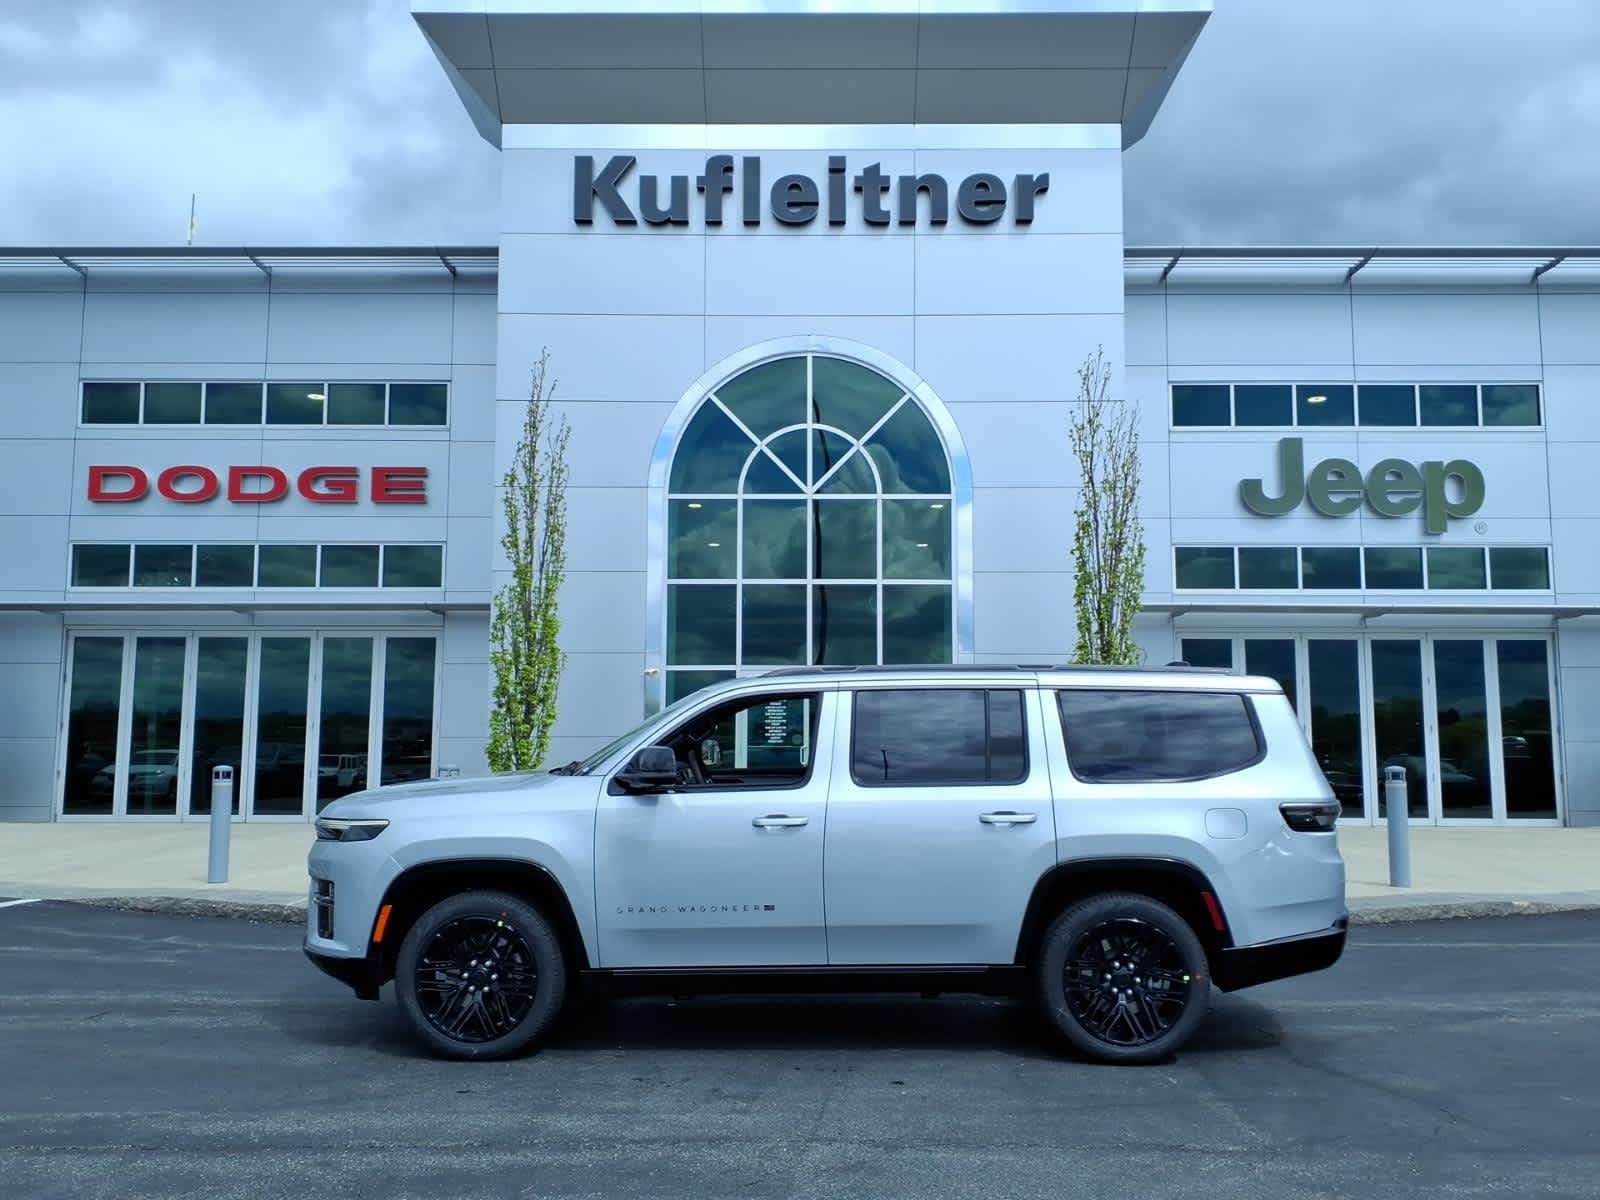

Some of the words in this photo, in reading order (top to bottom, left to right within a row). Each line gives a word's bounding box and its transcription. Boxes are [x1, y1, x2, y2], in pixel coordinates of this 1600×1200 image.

[574, 155, 1050, 226] Kufleitner
[87, 465, 429, 504] DODGE
[1239, 437, 1485, 535] Jeep
[616, 905, 667, 913] GRAND
[678, 905, 760, 913] WAGONEER
